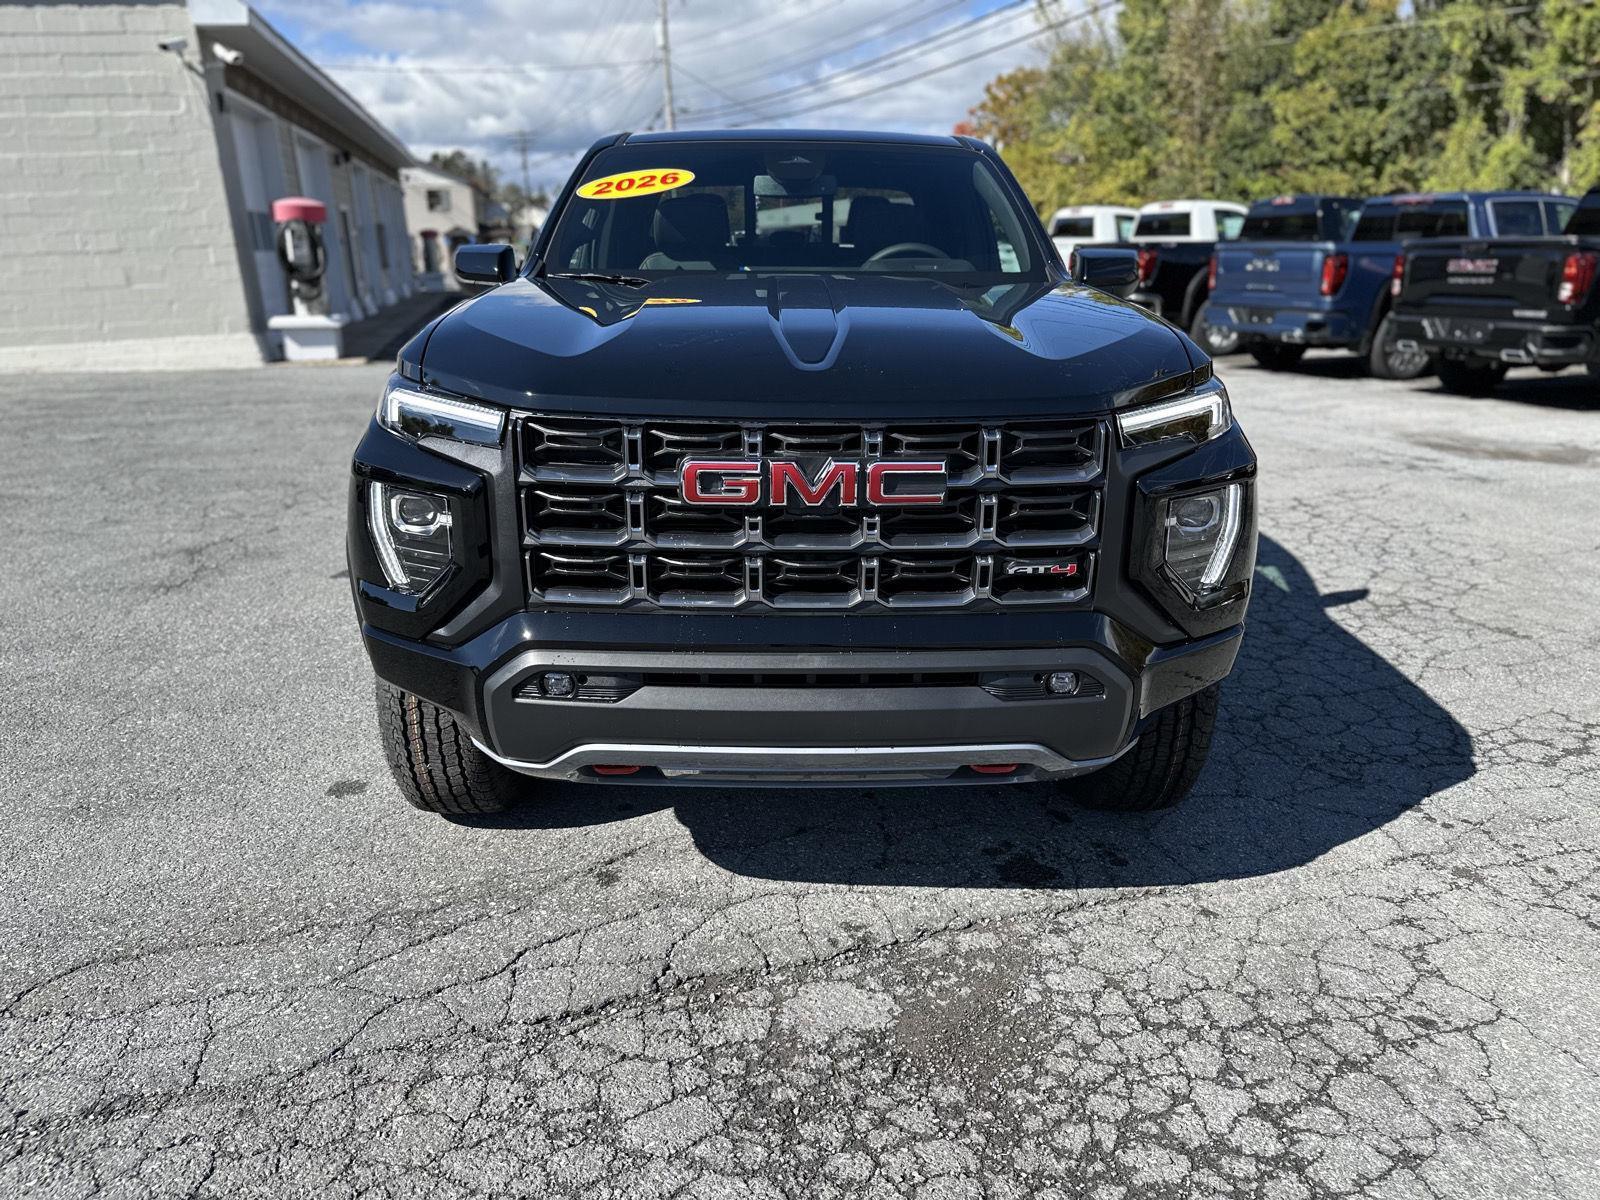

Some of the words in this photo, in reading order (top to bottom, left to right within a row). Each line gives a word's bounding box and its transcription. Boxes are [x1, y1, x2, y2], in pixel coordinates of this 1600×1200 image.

[592, 173, 680, 195] 2026
[683, 459, 947, 506] GMC
[1007, 562, 1077, 576] AT4
